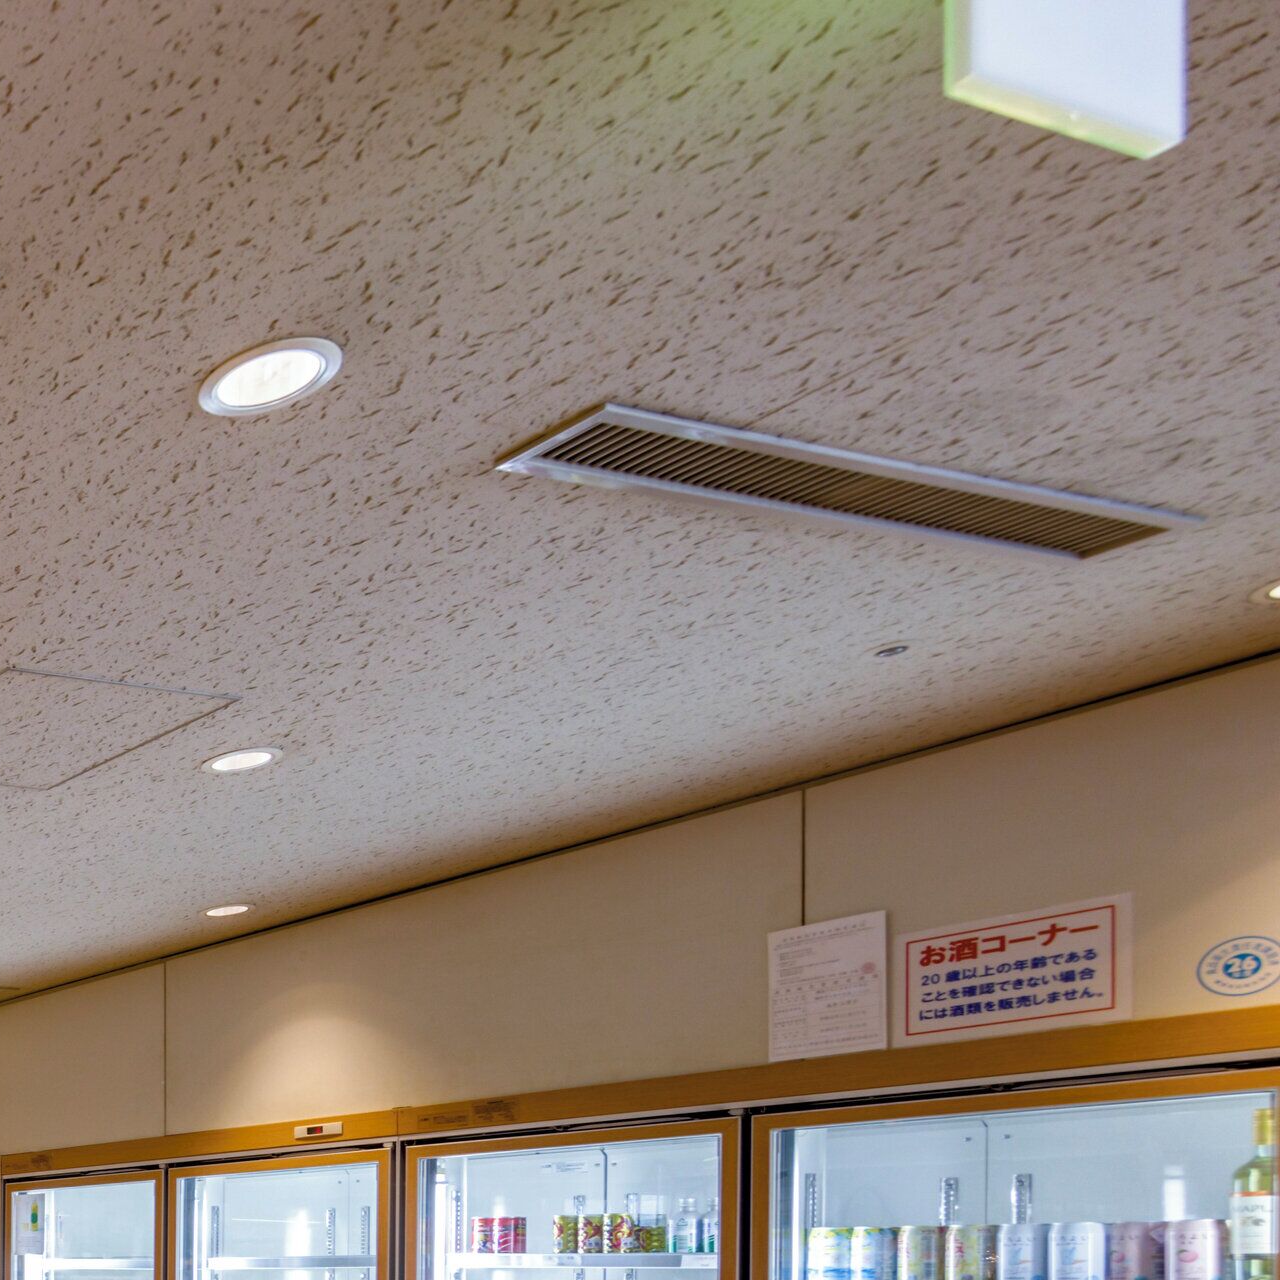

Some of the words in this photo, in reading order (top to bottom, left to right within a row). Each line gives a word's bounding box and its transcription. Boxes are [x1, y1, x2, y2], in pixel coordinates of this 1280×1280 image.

[919, 923, 1100, 967] お酒コーナー
[920, 967, 1097, 1003] ことを確認できない場合
[919, 987, 1104, 1021] には酒類を販売しません。
